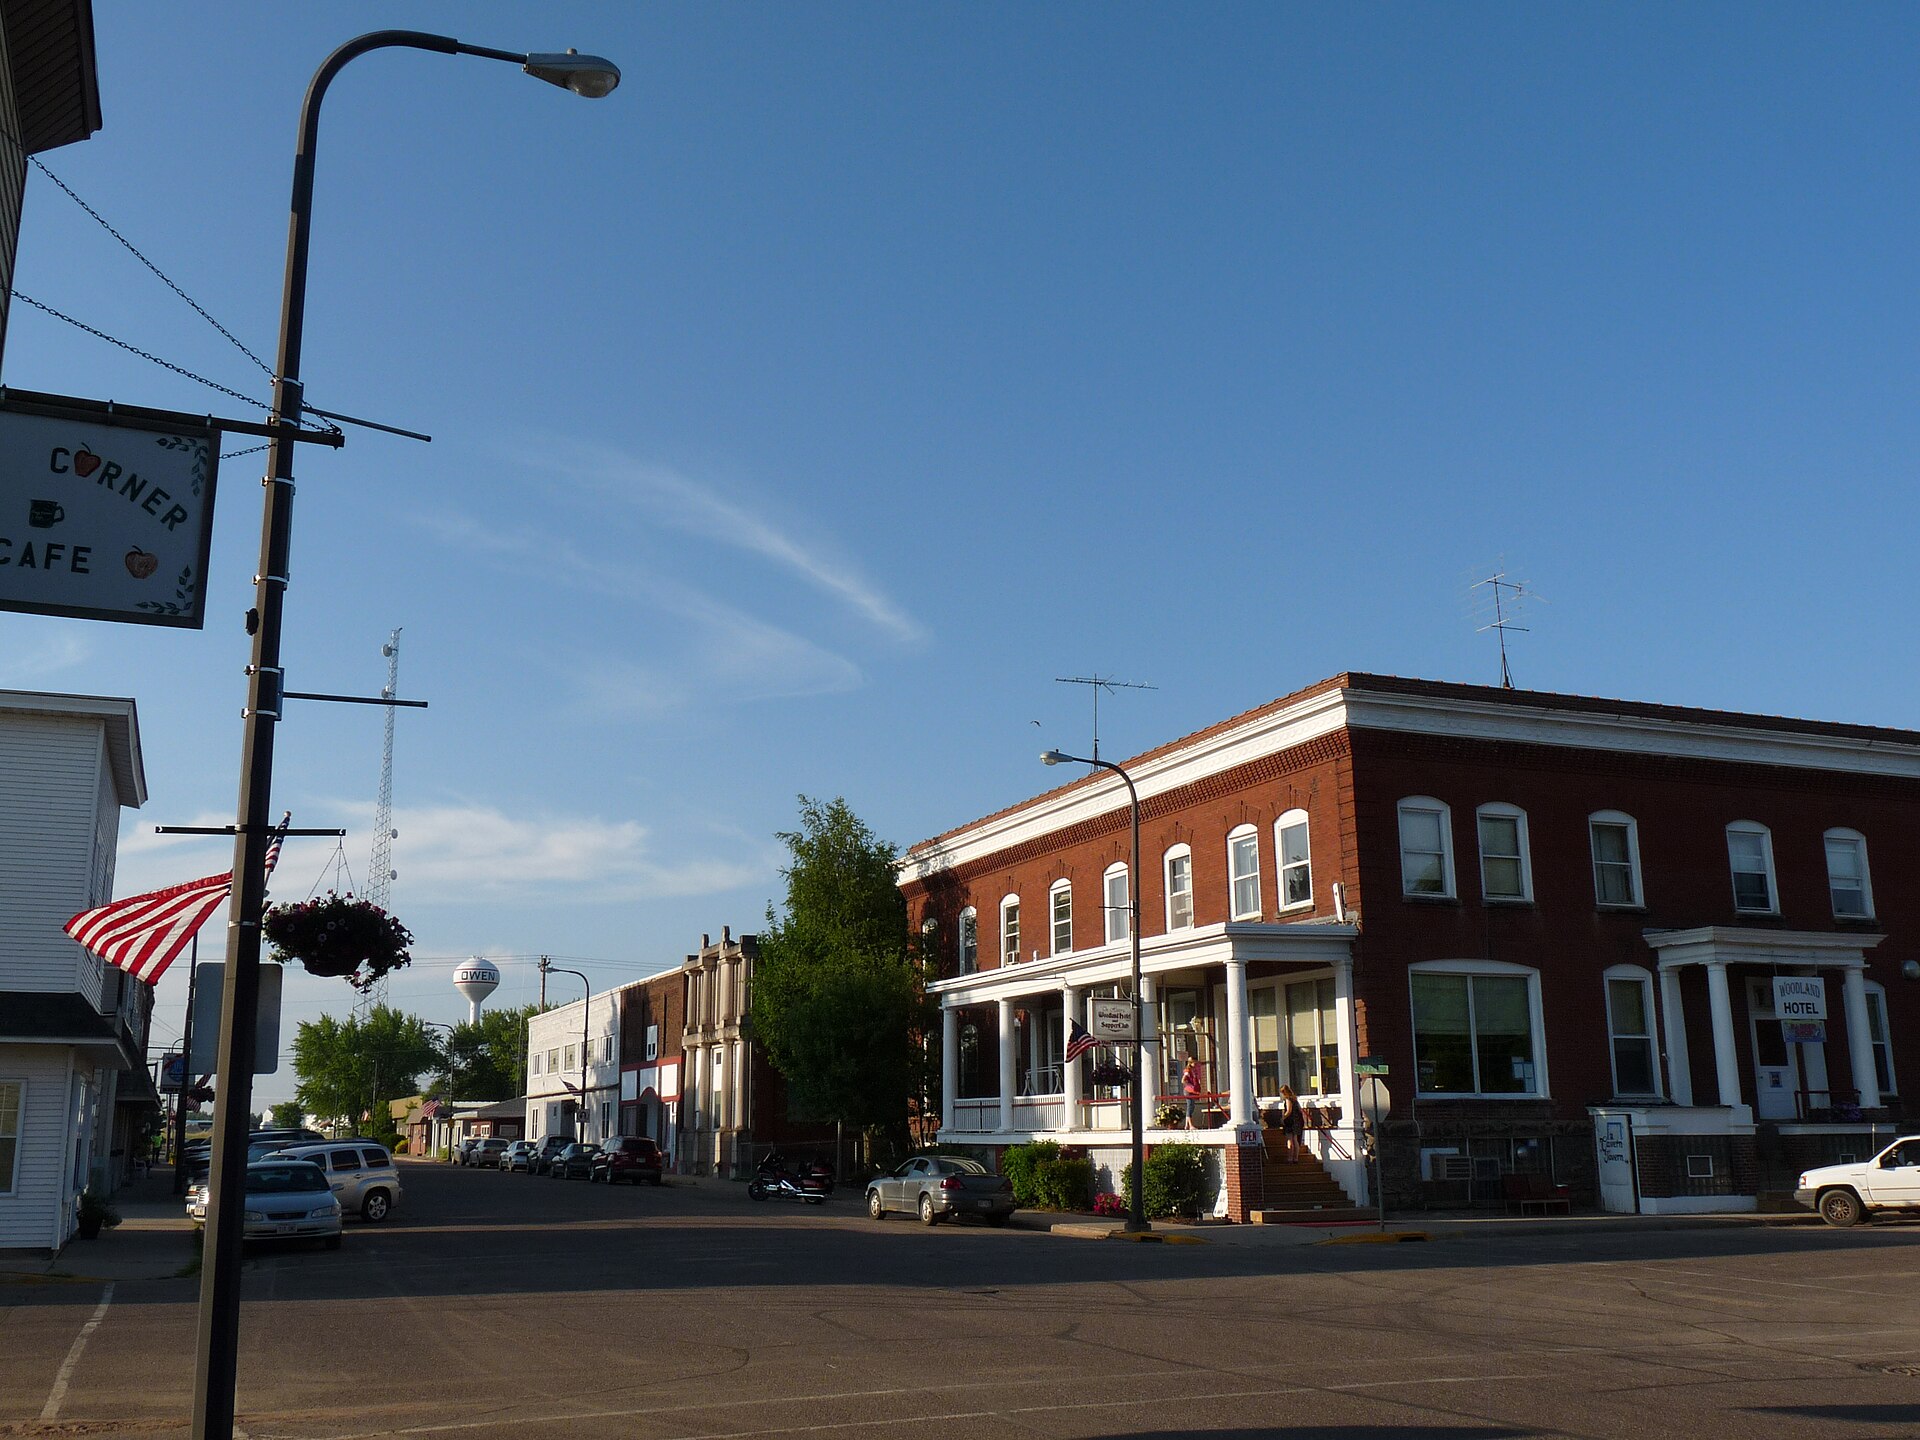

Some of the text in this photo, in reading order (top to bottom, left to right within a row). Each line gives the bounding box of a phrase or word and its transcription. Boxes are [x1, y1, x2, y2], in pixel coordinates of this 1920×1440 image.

[0, 537, 92, 574] CAFE
[461, 971, 496, 981] OWEN
[1778, 982, 1821, 998] WOODLAND
[1783, 1002, 1819, 1014] HOTEL
[1240, 1131, 1257, 1141] OPEN
